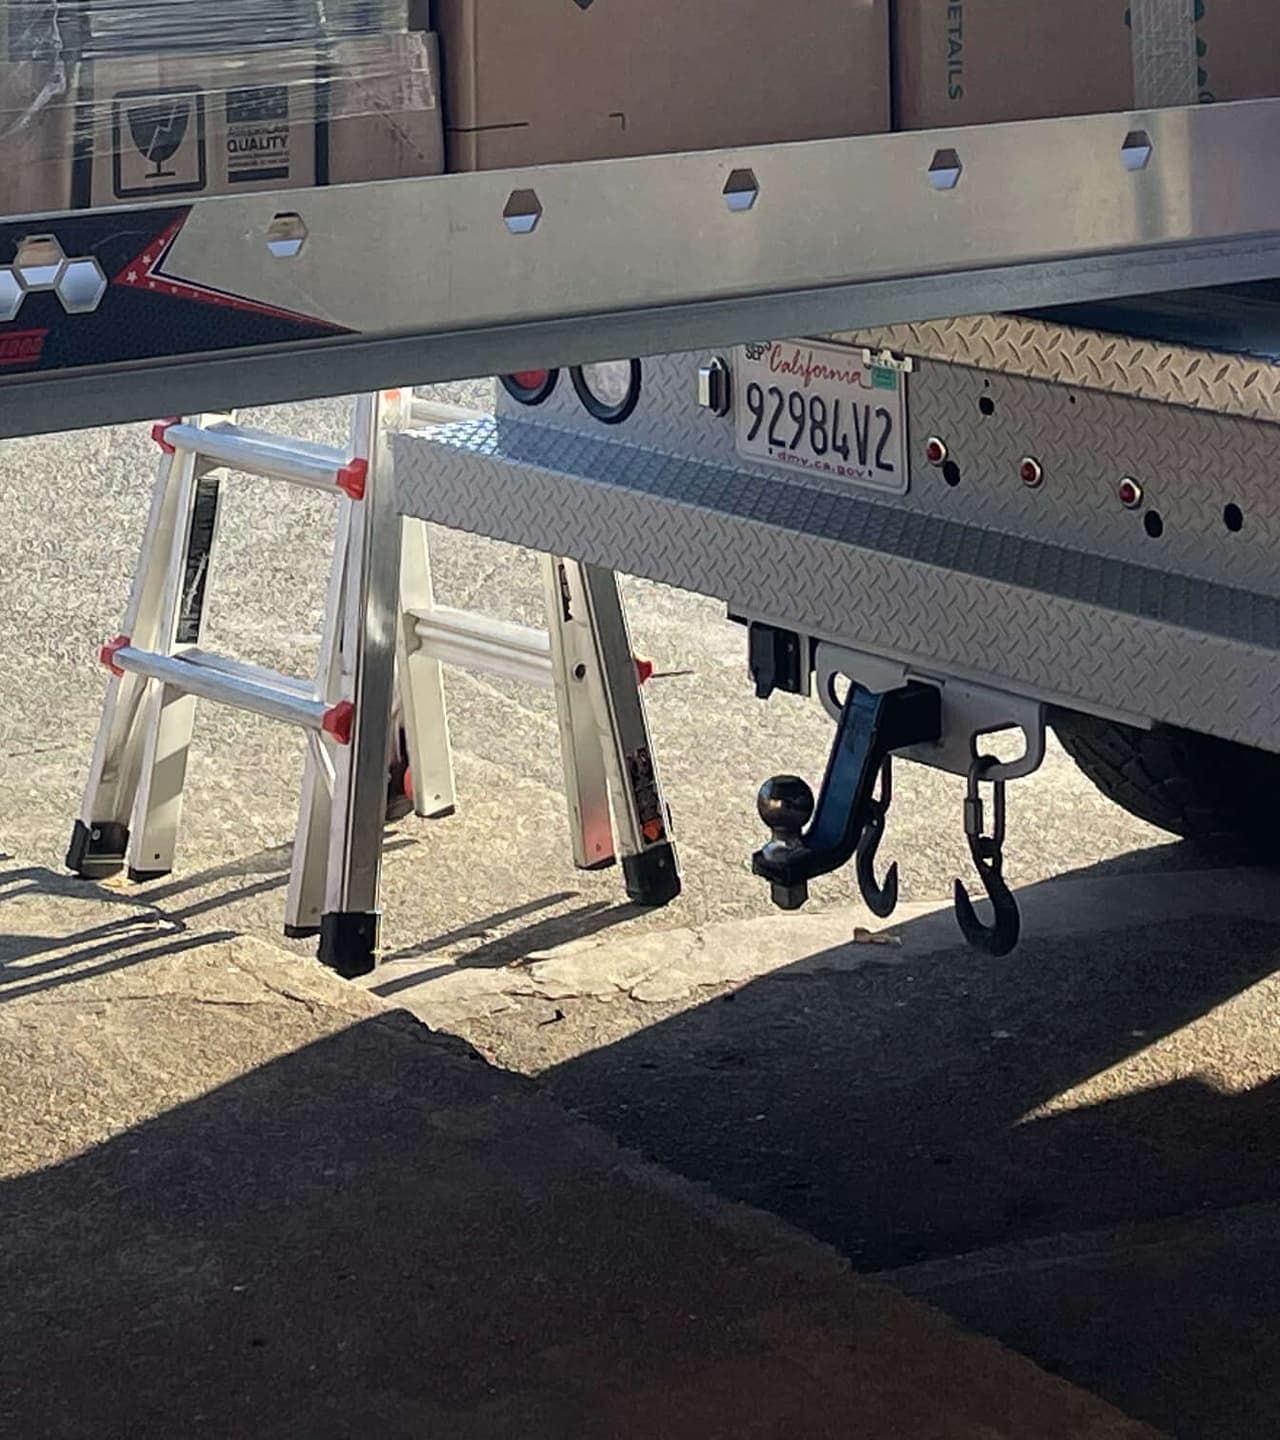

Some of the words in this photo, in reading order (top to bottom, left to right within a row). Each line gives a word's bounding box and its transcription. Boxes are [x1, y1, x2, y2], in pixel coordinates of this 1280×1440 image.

[226, 135, 289, 153] QUALITY
[770, 343, 873, 389] California
[746, 382, 895, 473] 92984V2
[776, 450, 866, 477] dmv.ca.gov
